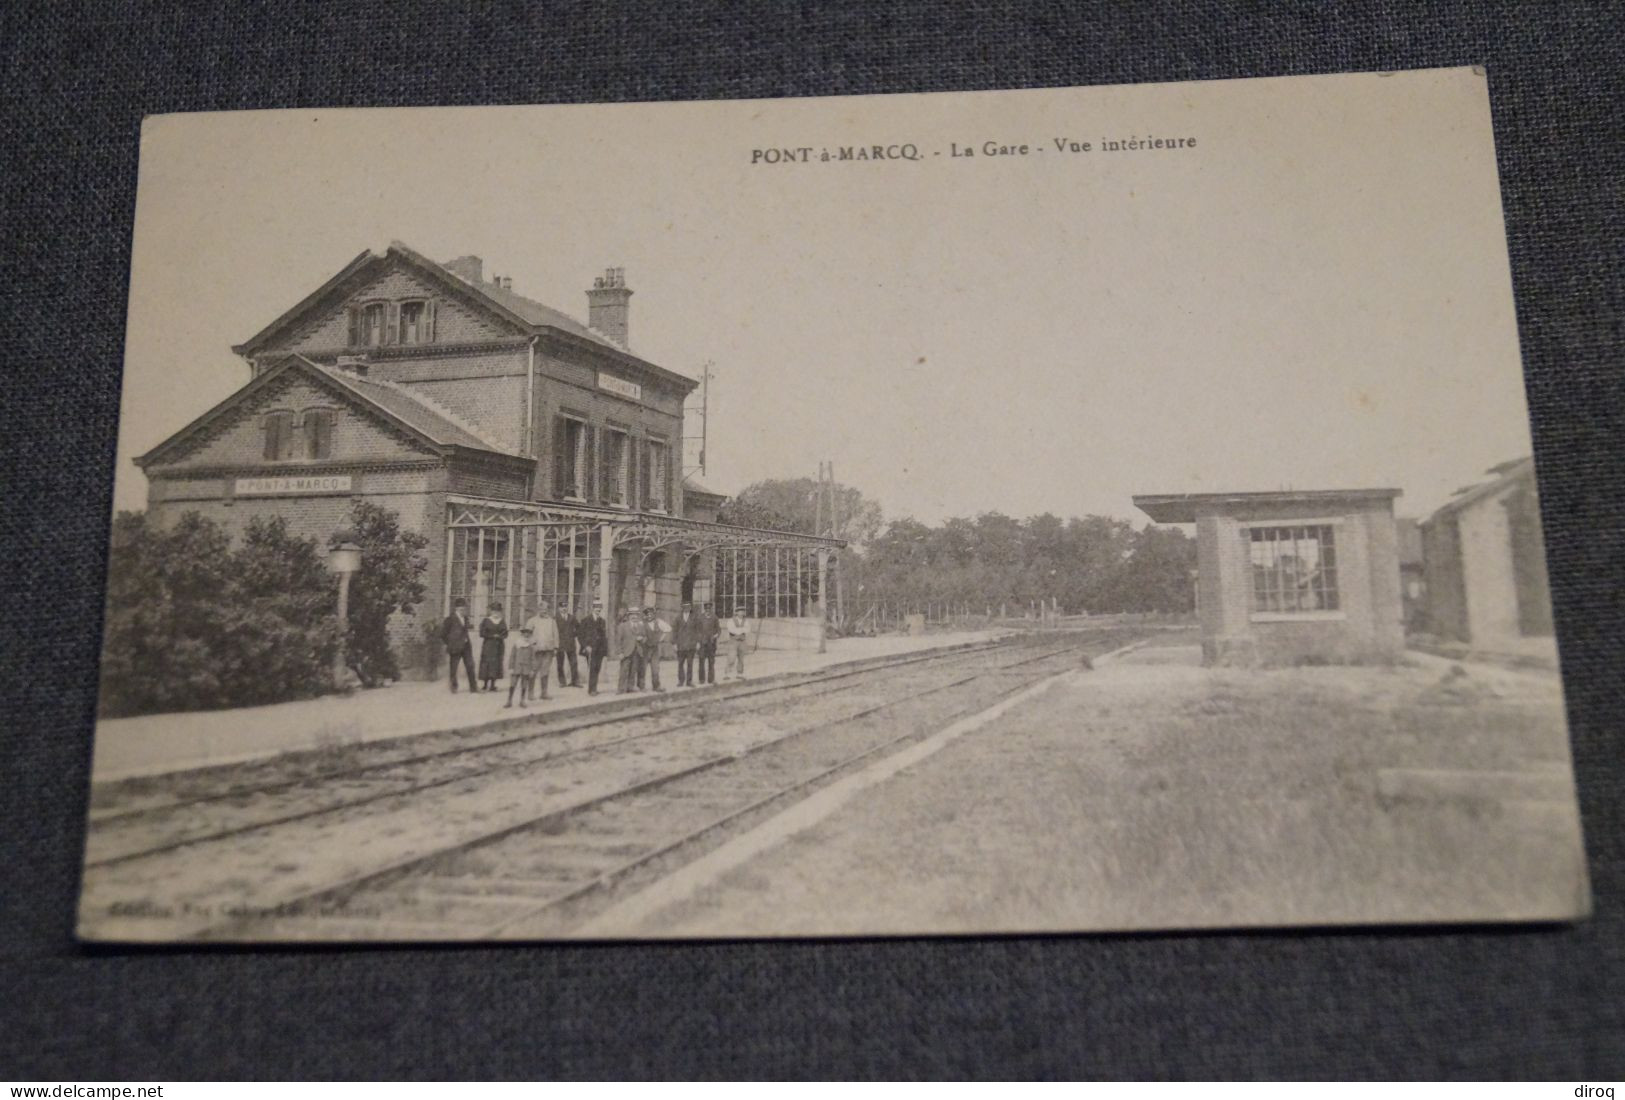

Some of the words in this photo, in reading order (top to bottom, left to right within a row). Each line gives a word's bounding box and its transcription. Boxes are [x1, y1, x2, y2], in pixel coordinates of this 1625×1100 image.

[951, 142, 975, 158] La
[982, 140, 1029, 157] Gare
[1053, 137, 1092, 153] Vue
[1101, 135, 1197, 152] intérieure
